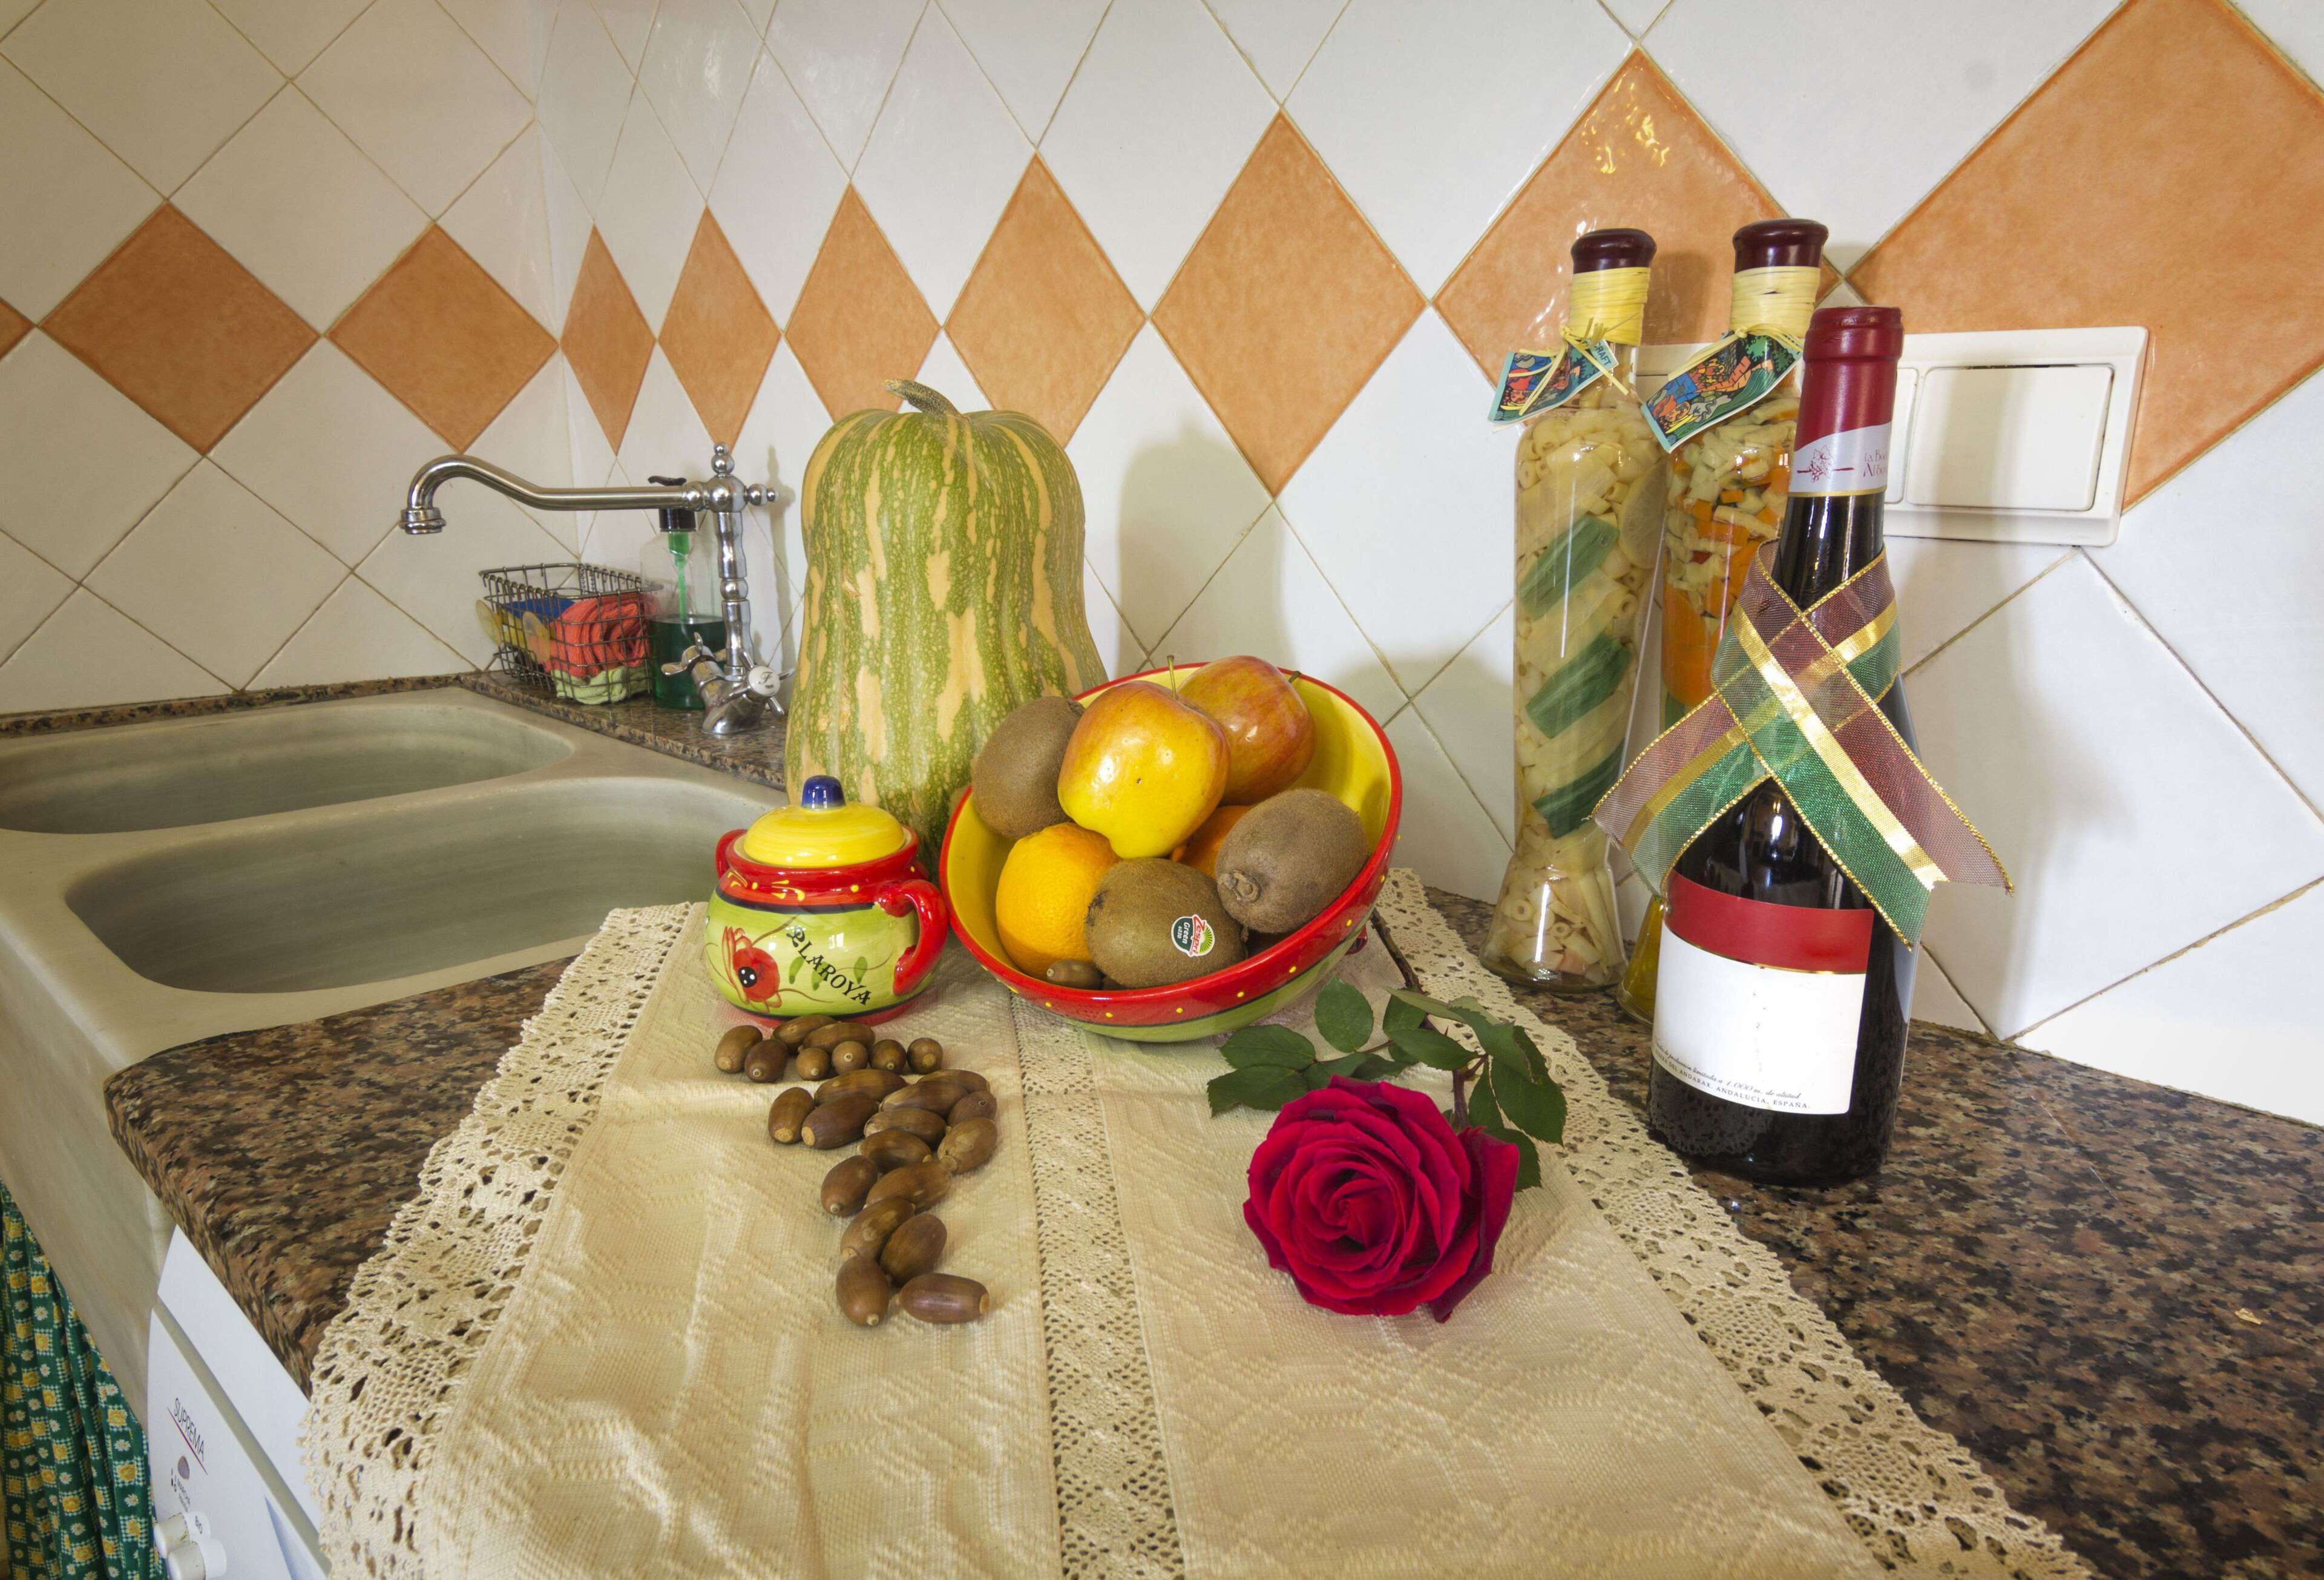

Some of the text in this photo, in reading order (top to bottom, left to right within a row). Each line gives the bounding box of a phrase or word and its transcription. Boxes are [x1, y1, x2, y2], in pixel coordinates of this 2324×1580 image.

[1181, 922, 1190, 944] Green
[1191, 916, 1206, 955] Zespri
[1726, 1081, 1753, 1091] 1.000
[174, 1397, 204, 1463] SUPREMA
